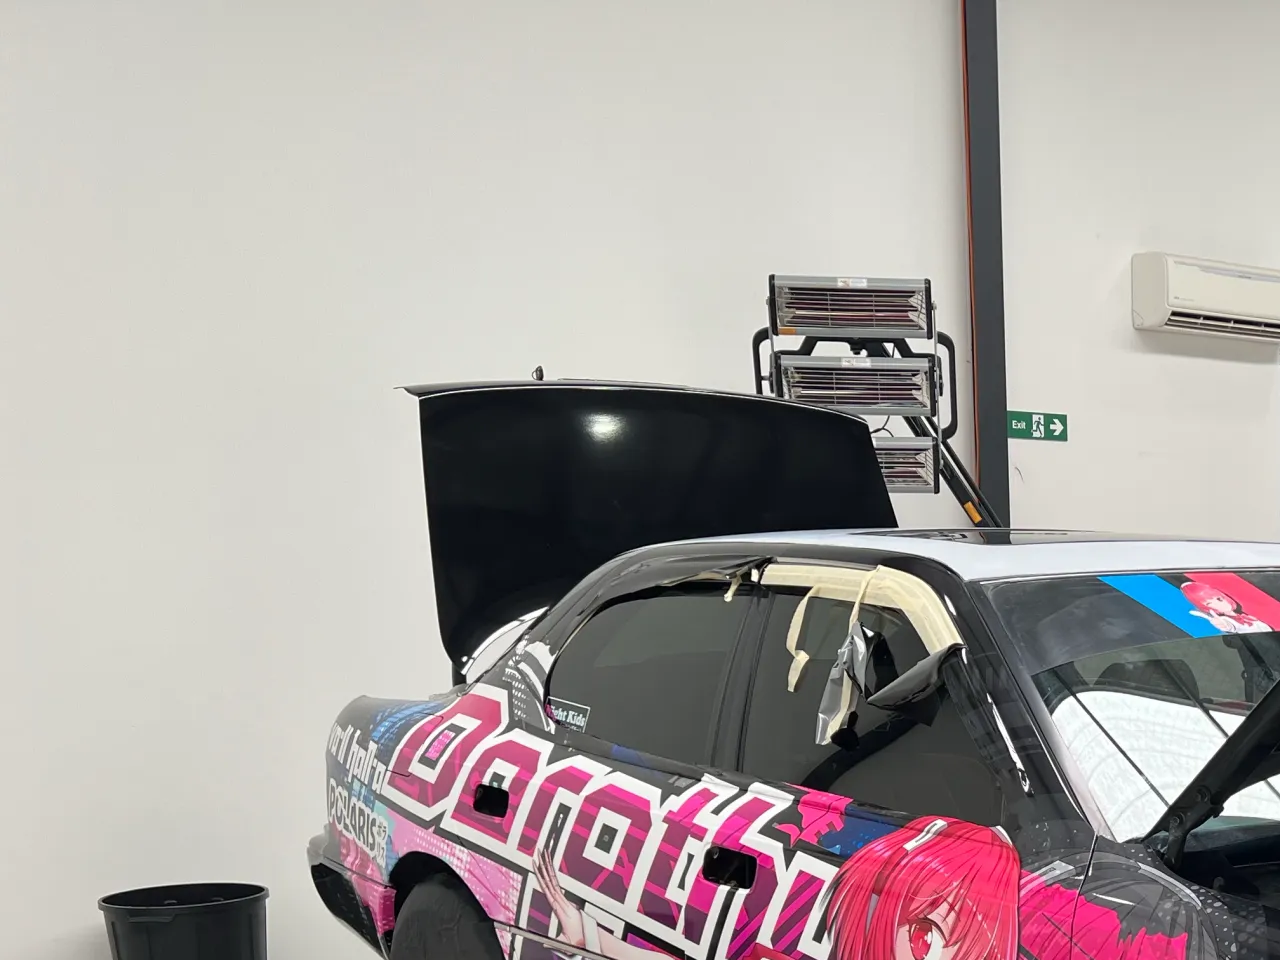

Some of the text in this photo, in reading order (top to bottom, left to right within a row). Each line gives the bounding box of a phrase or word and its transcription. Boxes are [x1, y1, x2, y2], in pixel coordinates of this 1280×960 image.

[1012, 420, 1026, 429] Exit
[566, 710, 586, 727] Kids
[328, 779, 378, 852] POLARIS
